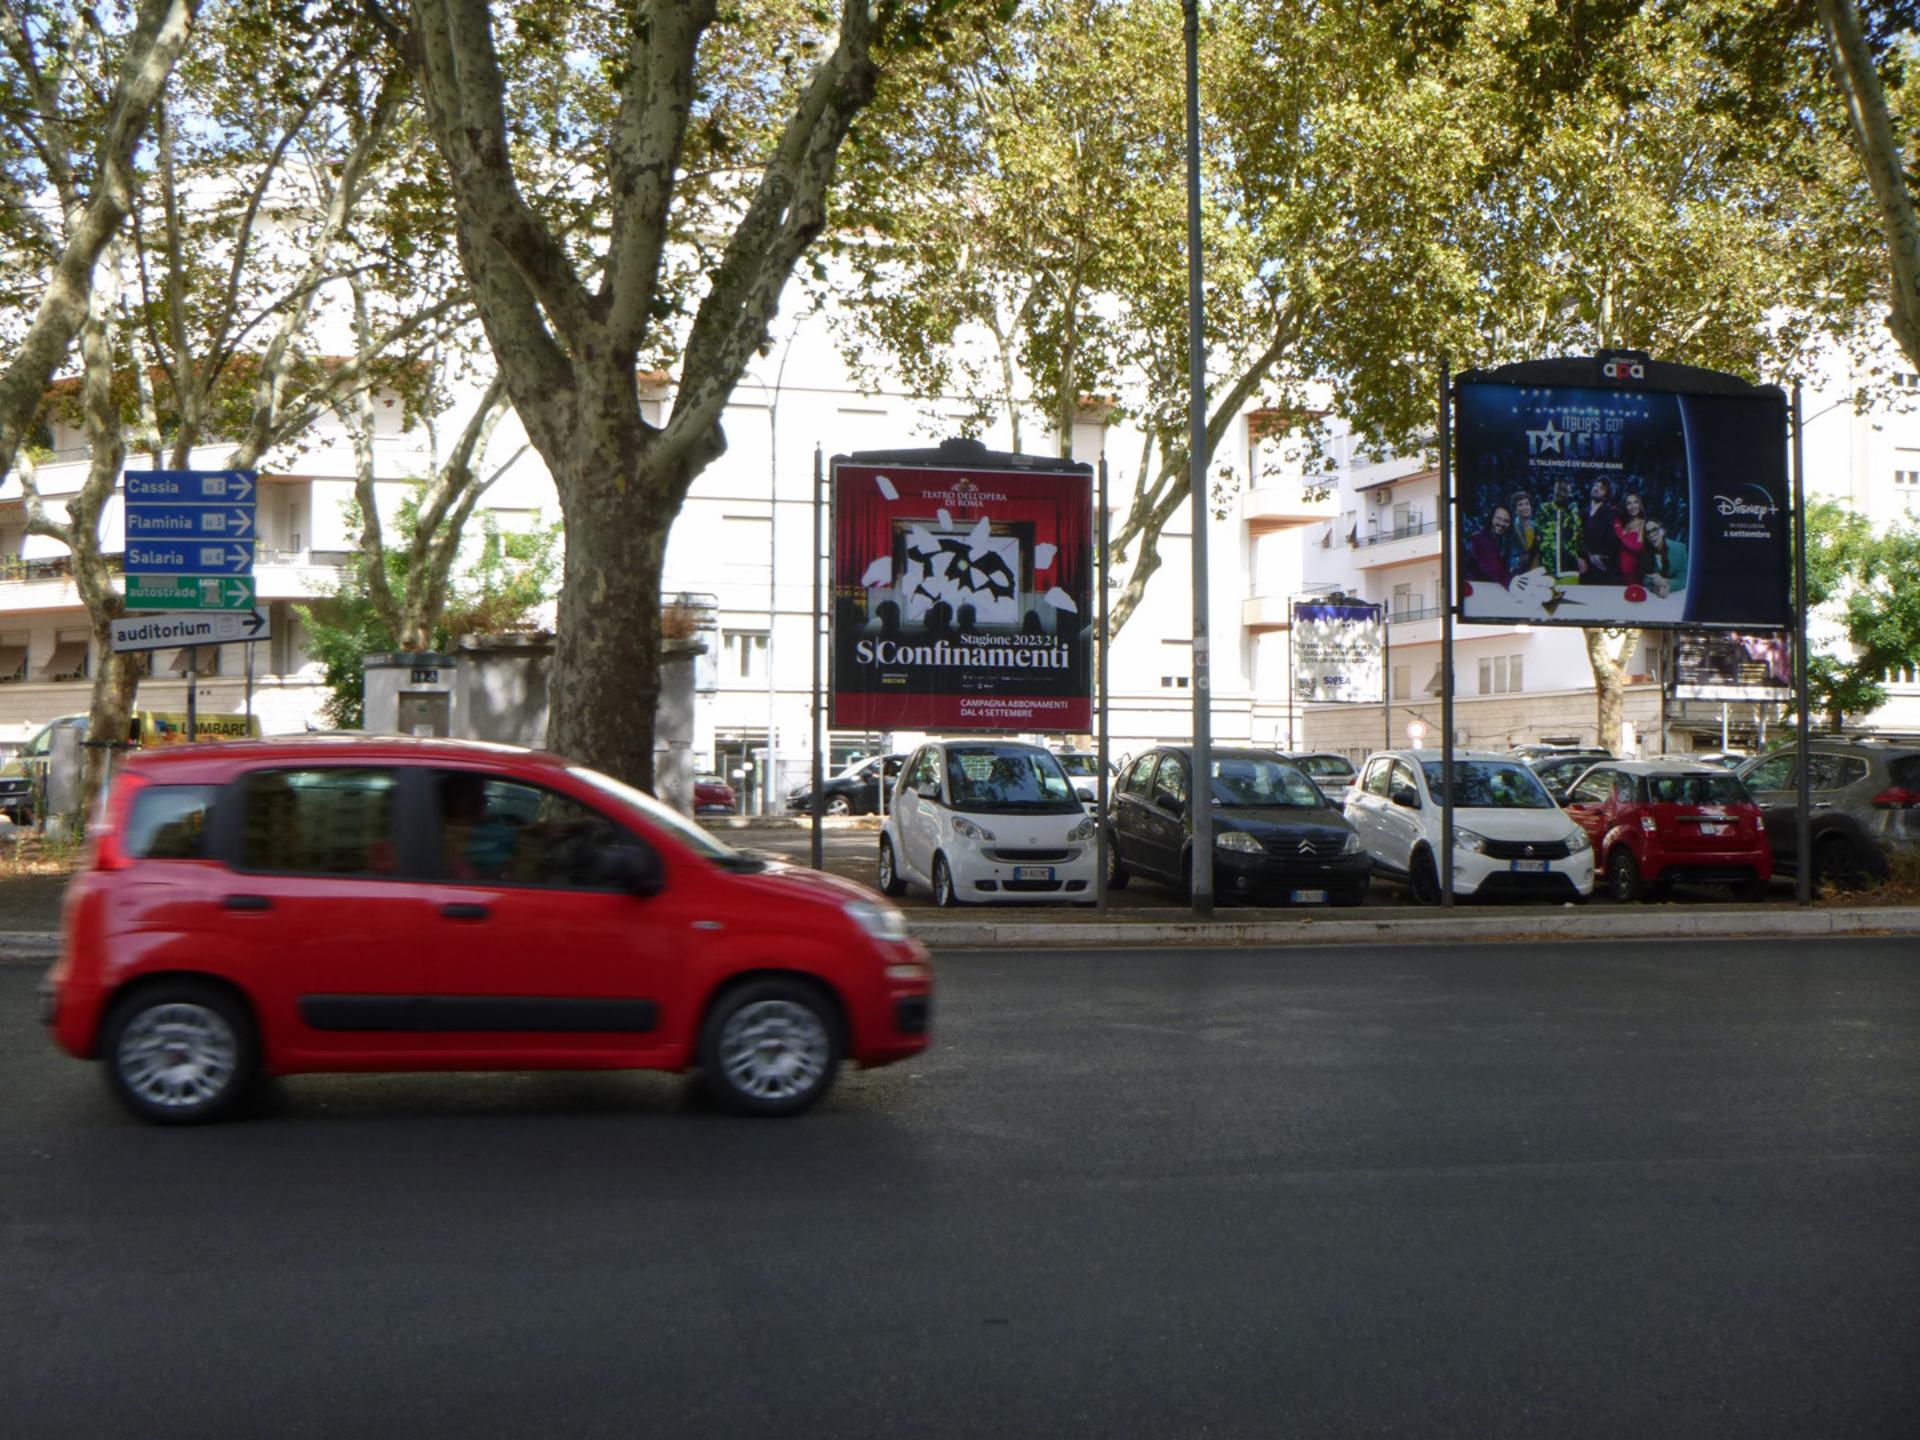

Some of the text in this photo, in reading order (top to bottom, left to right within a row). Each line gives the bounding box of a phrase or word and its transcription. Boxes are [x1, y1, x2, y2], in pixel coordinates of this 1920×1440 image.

[128, 479, 179, 494] Cassia
[922, 490, 956, 500] TEATRO
[945, 499, 984, 508] DI ROMA
[128, 514, 193, 529] Flaminia
[129, 549, 184, 565] Salaria
[129, 587, 197, 598] autostrade
[118, 621, 211, 642] auditorium
[960, 633, 1011, 646] Stagione
[960, 699, 1068, 709] CAMPAGNA ABBONAMENTI
[960, 708, 977, 717] DAL
[985, 709, 1033, 718] SETTEMBRE
